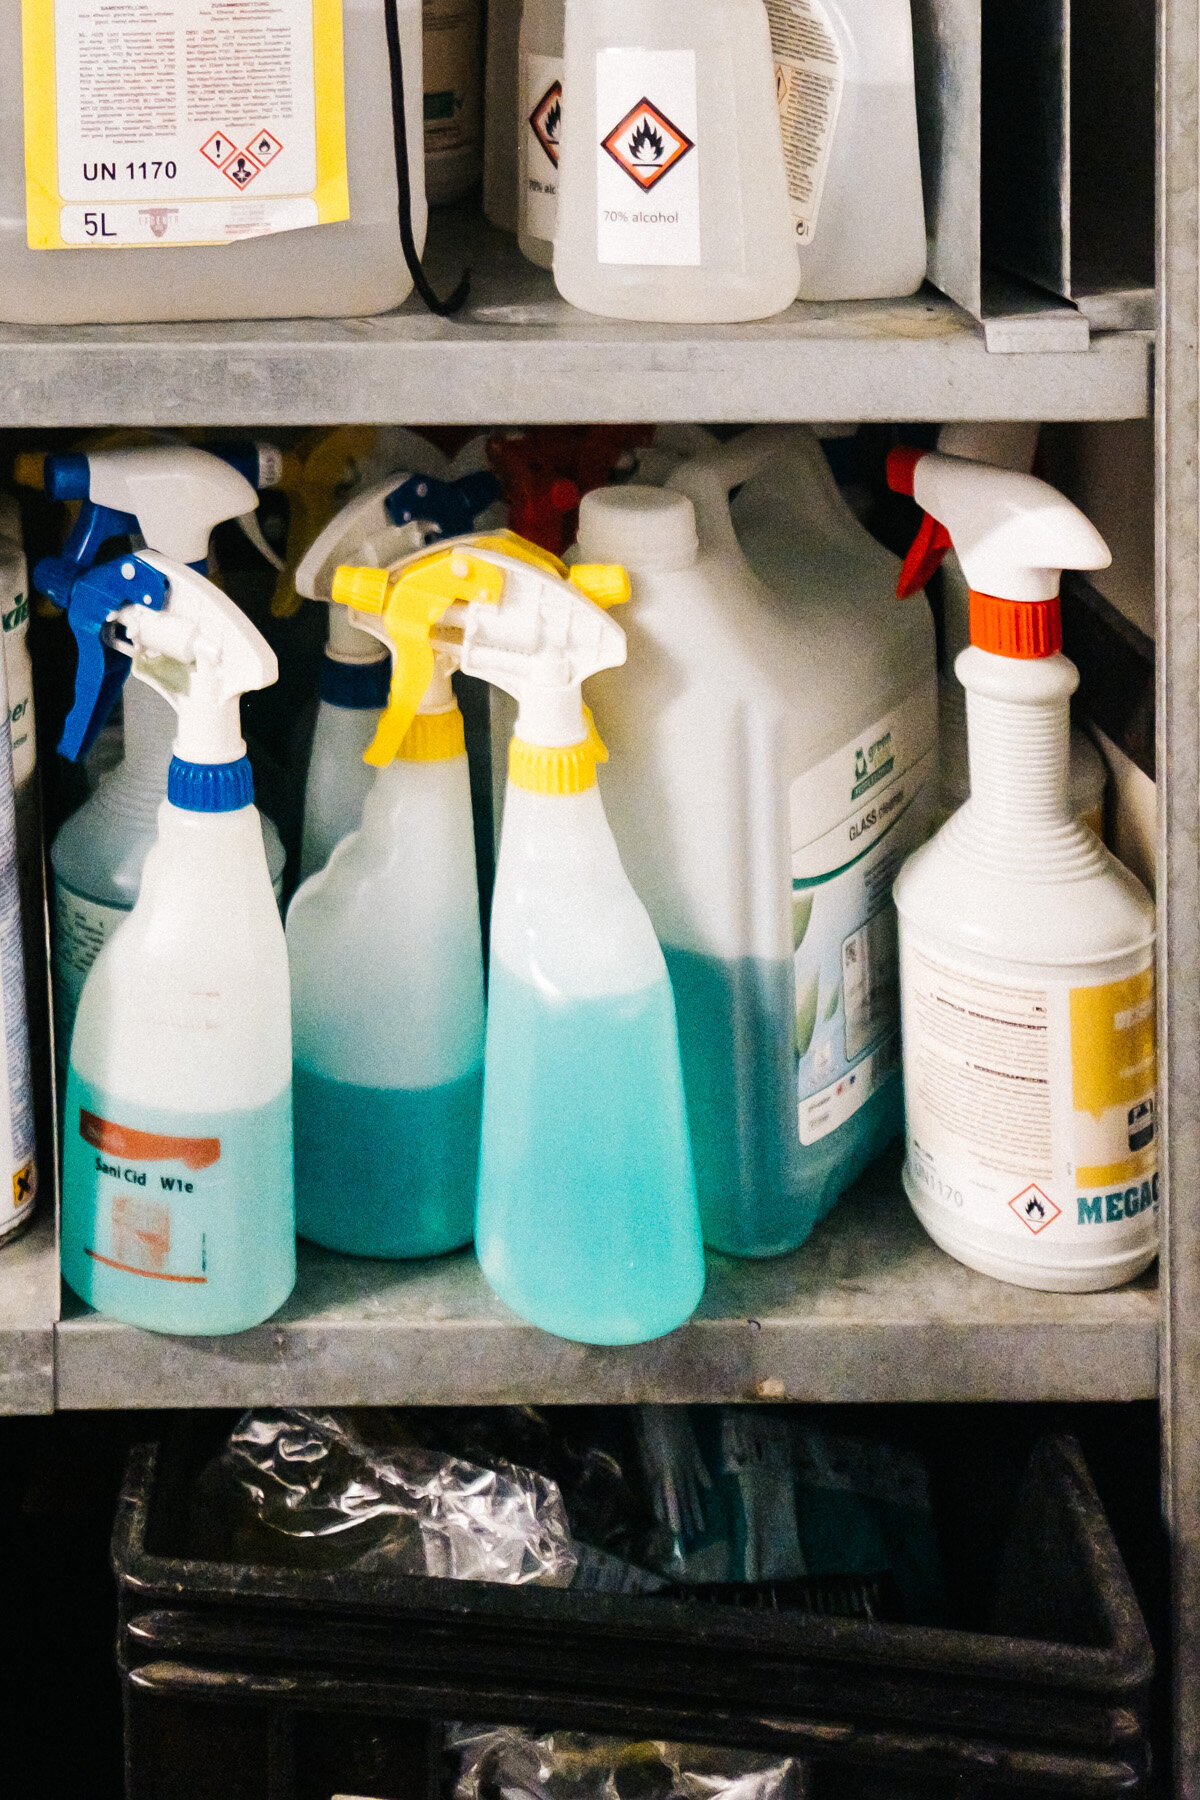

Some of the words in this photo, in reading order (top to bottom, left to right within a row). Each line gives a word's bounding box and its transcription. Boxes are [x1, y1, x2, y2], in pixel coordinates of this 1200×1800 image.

[83, 162, 117, 181] UN
[126, 161, 177, 180] 1170
[84, 212, 118, 236] 5L
[604, 210, 629, 223] 70%
[632, 211, 679, 224] alcohol
[849, 808, 877, 841] GLASS
[95, 1157, 121, 1179] Sani
[124, 1168, 147, 1187] Cid
[160, 1176, 194, 1194] W1e
